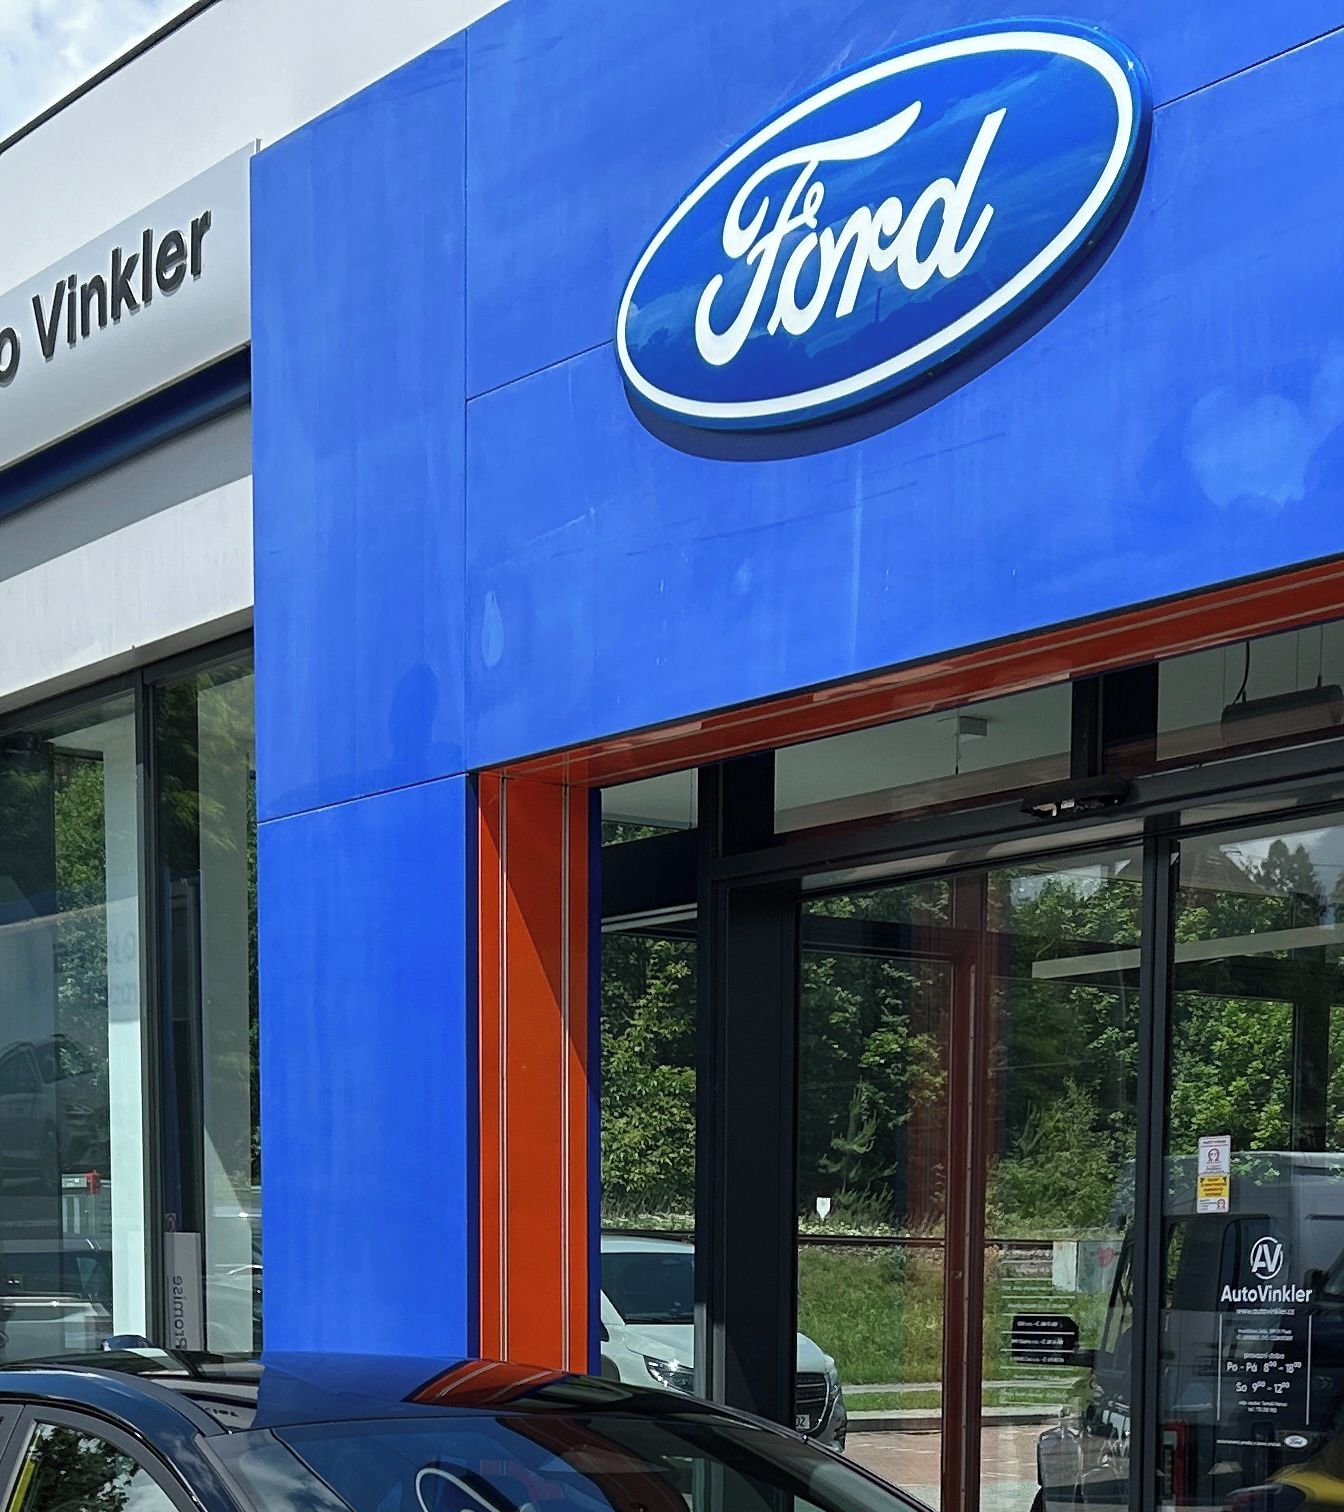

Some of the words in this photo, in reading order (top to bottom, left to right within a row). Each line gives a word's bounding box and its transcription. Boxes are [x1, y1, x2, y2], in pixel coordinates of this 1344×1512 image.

[696, 101, 1006, 367] Ford
[32, 210, 212, 363] Vinkler
[1220, 1284, 1313, 1303] AutoVinkler
[1251, 1243, 1282, 1273] AV
